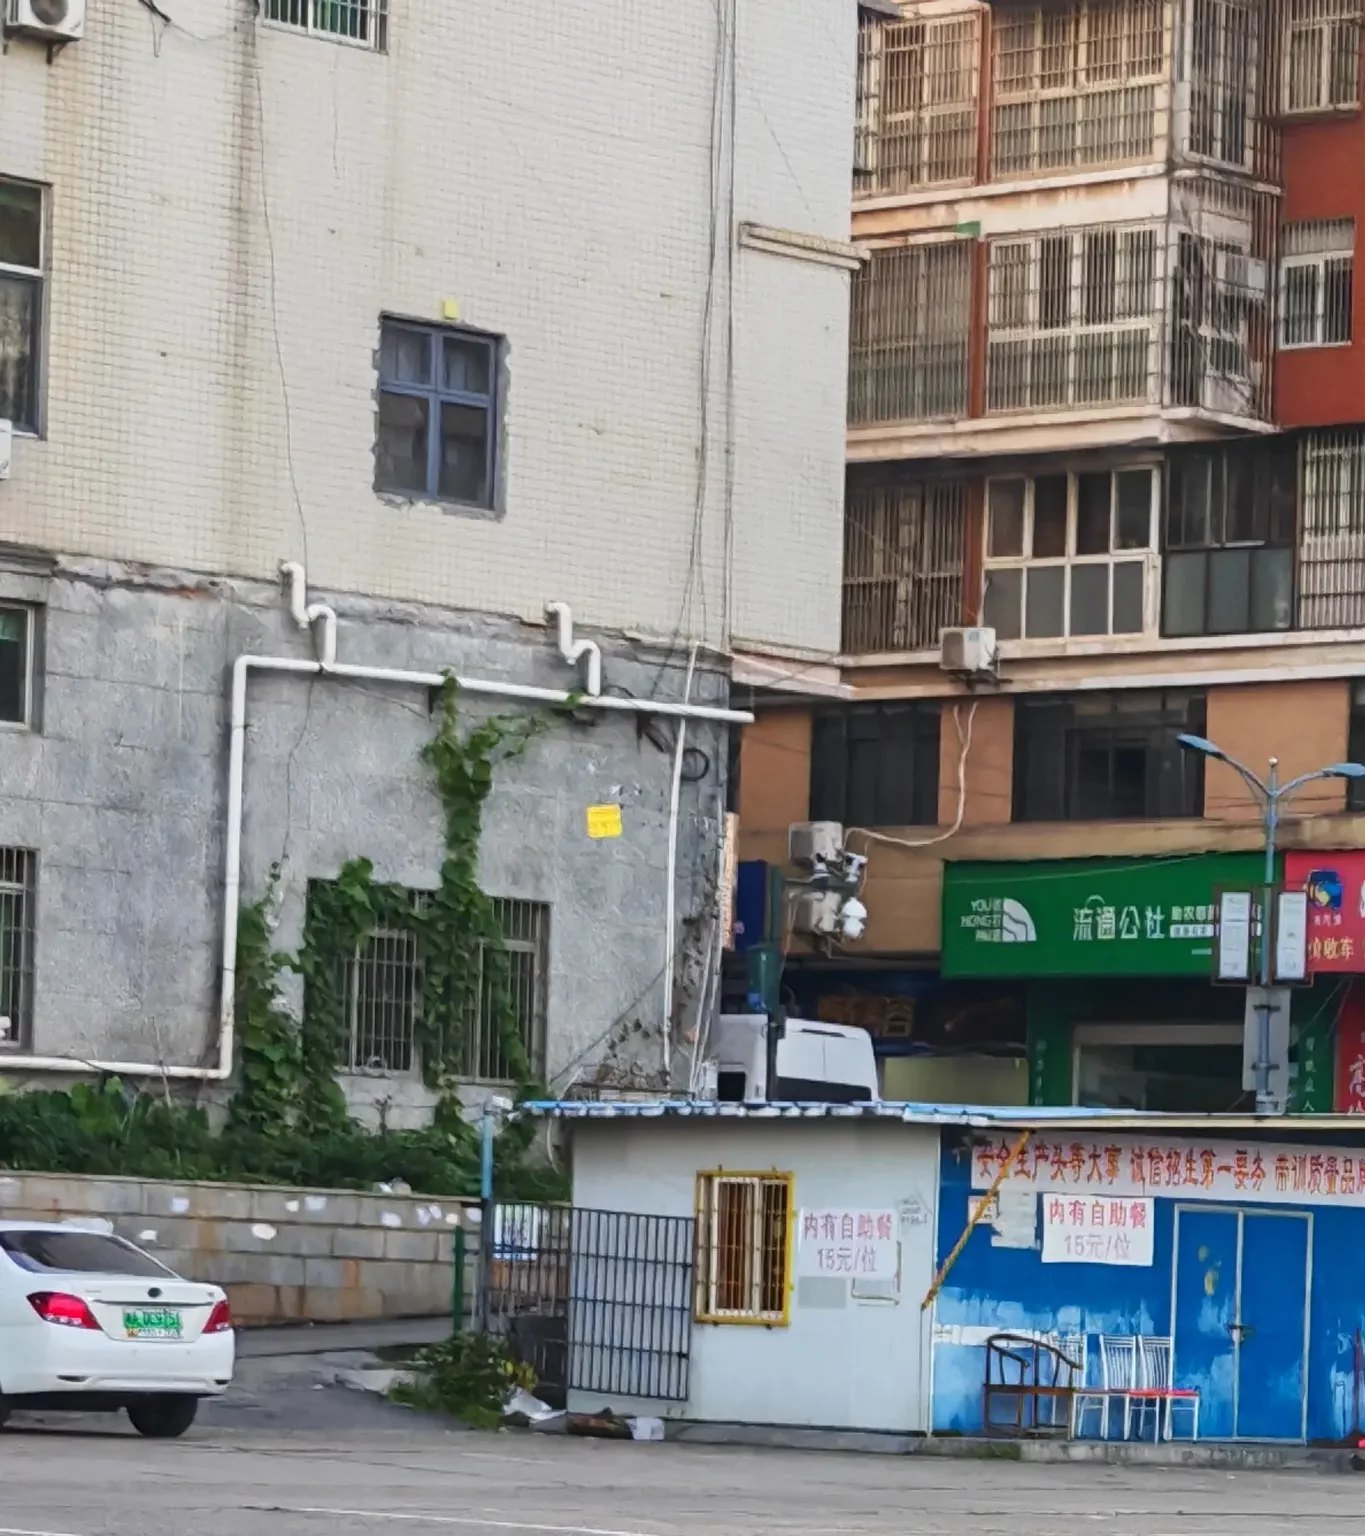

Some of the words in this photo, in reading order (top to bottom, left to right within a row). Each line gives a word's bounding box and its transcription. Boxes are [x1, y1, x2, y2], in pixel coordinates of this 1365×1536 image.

[977, 1138, 1122, 1185] 安全生产头等大事
[804, 1212, 893, 1241] 内有自助餐
[1049, 1200, 1148, 1230] 内有自助餐
[1064, 1231, 1131, 1261] 15元/位
